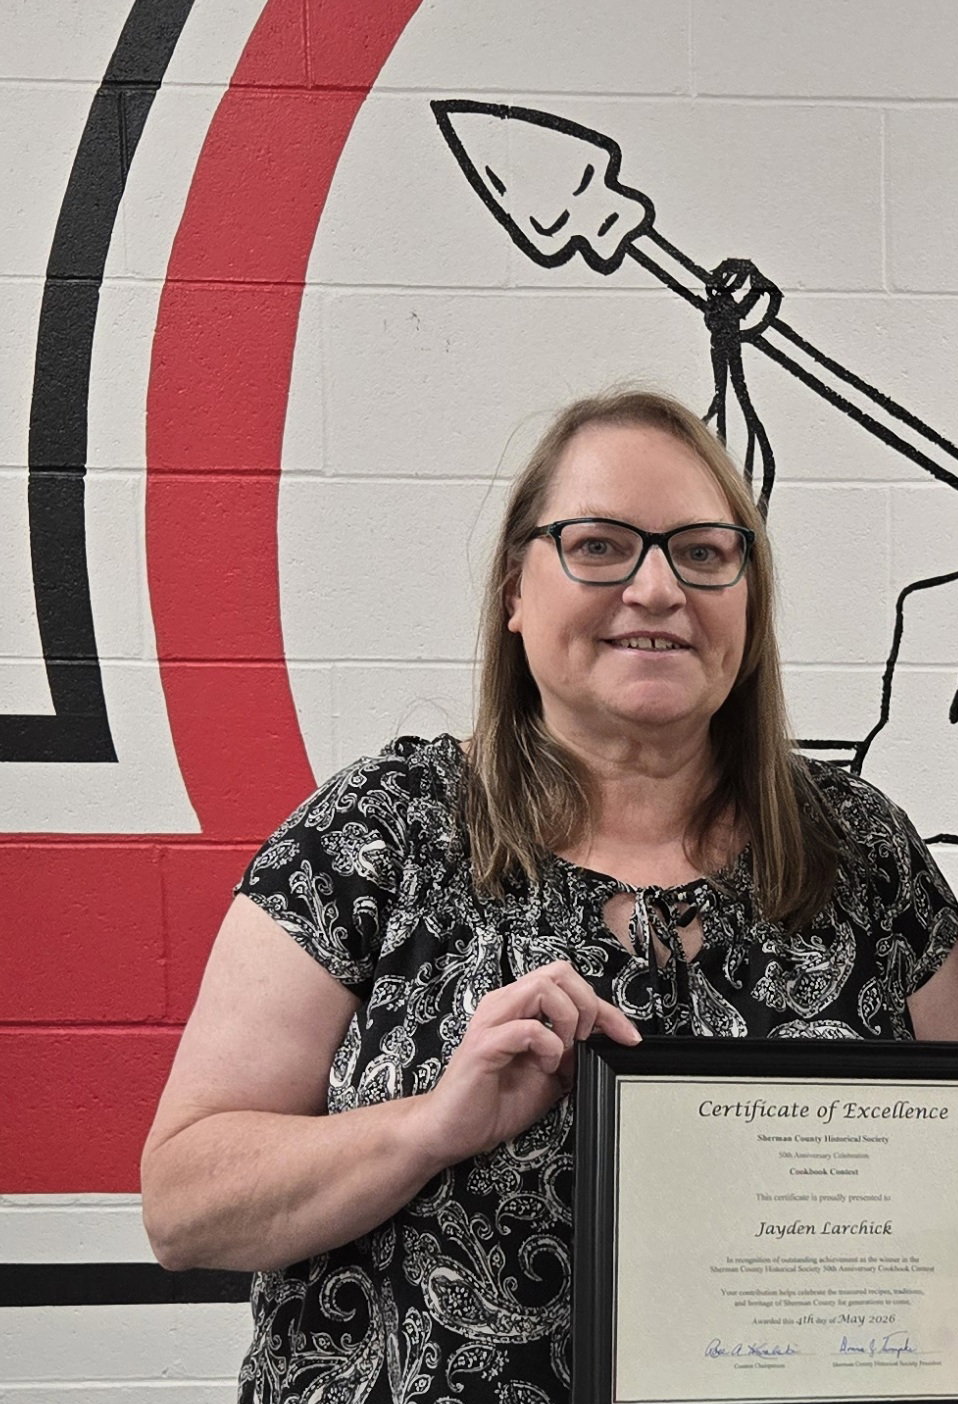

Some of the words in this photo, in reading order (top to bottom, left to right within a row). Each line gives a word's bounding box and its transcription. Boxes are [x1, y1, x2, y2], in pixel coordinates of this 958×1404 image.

[699, 1099, 809, 1123] Certificate
[817, 1099, 839, 1123] of
[843, 1101, 949, 1120] Excellence
[756, 1134, 792, 1142] Sherman
[794, 1134, 821, 1144] County
[824, 1134, 861, 1143] Historical
[862, 1135, 889, 1144] Society
[756, 1193, 772, 1201] This
[773, 1193, 809, 1201] certificate
[819, 1193, 846, 1203] proudly
[848, 1193, 882, 1203] presented
[755, 1221, 816, 1239] Jayden
[820, 1220, 893, 1235] Larchick
[837, 1314, 865, 1327] May
[868, 1314, 896, 1324] 2026
